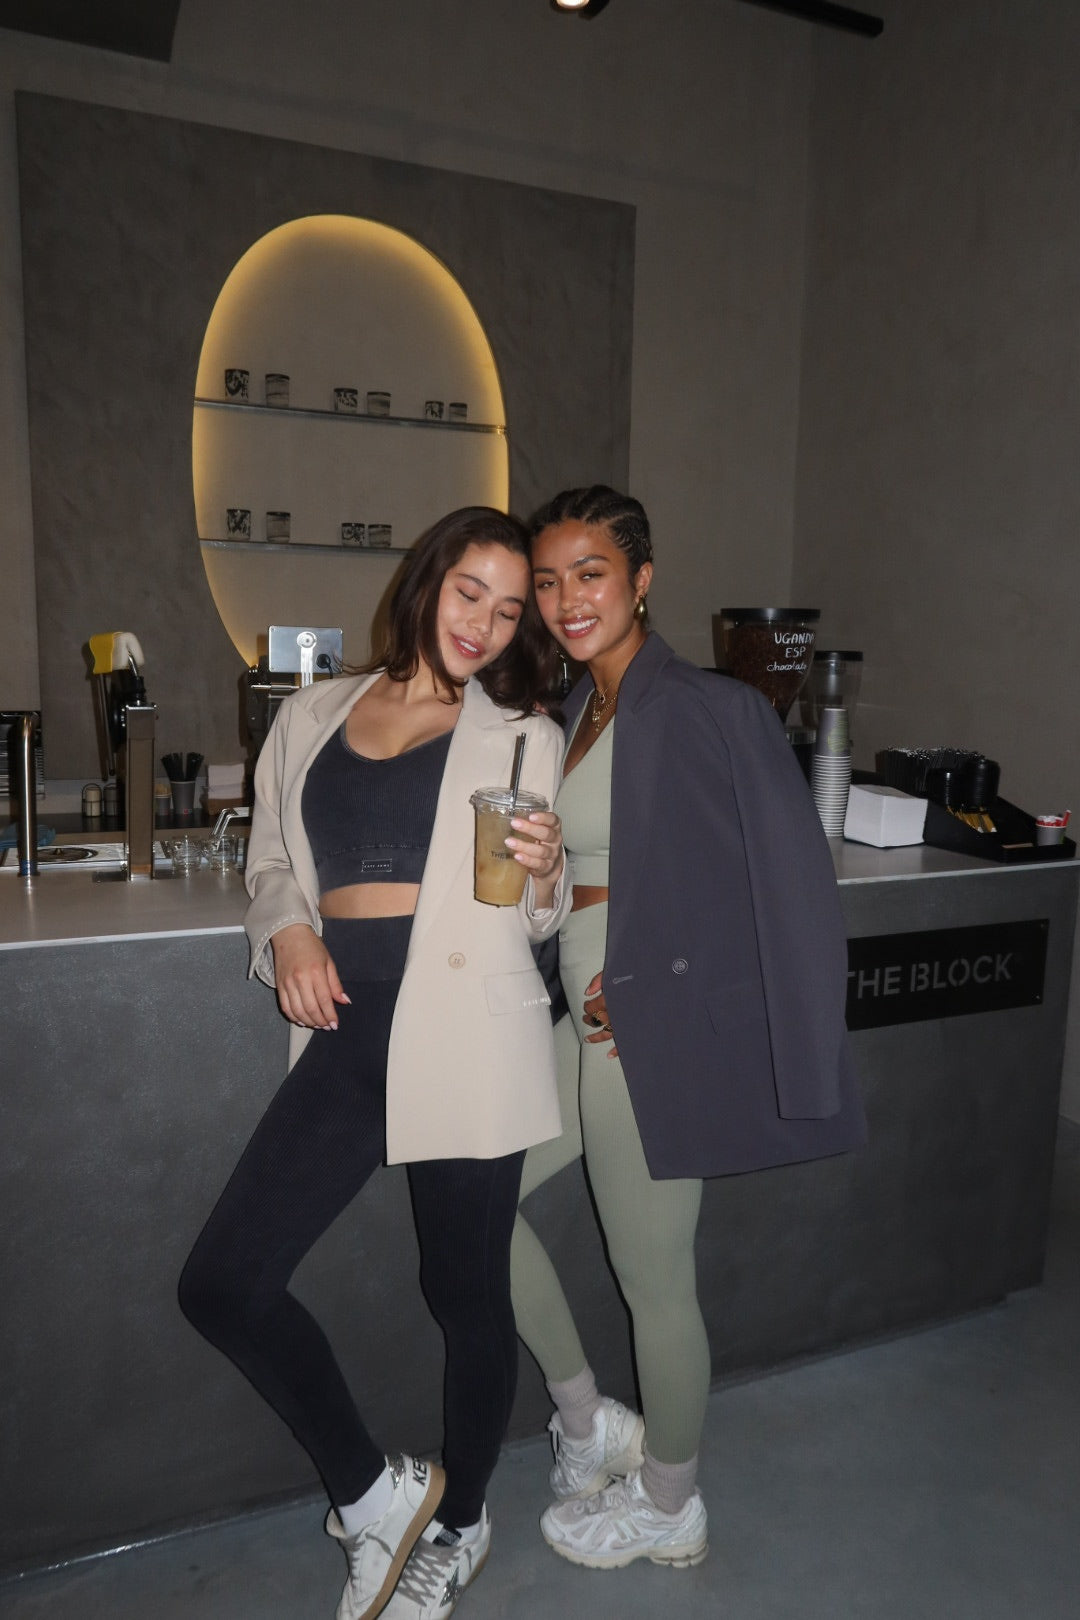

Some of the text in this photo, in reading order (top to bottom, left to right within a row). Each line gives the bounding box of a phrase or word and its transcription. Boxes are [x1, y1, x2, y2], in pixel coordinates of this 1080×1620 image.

[785, 646, 807, 658] ESP
[910, 952, 1013, 992] BLOCK
[412, 1457, 428, 1487] KE
